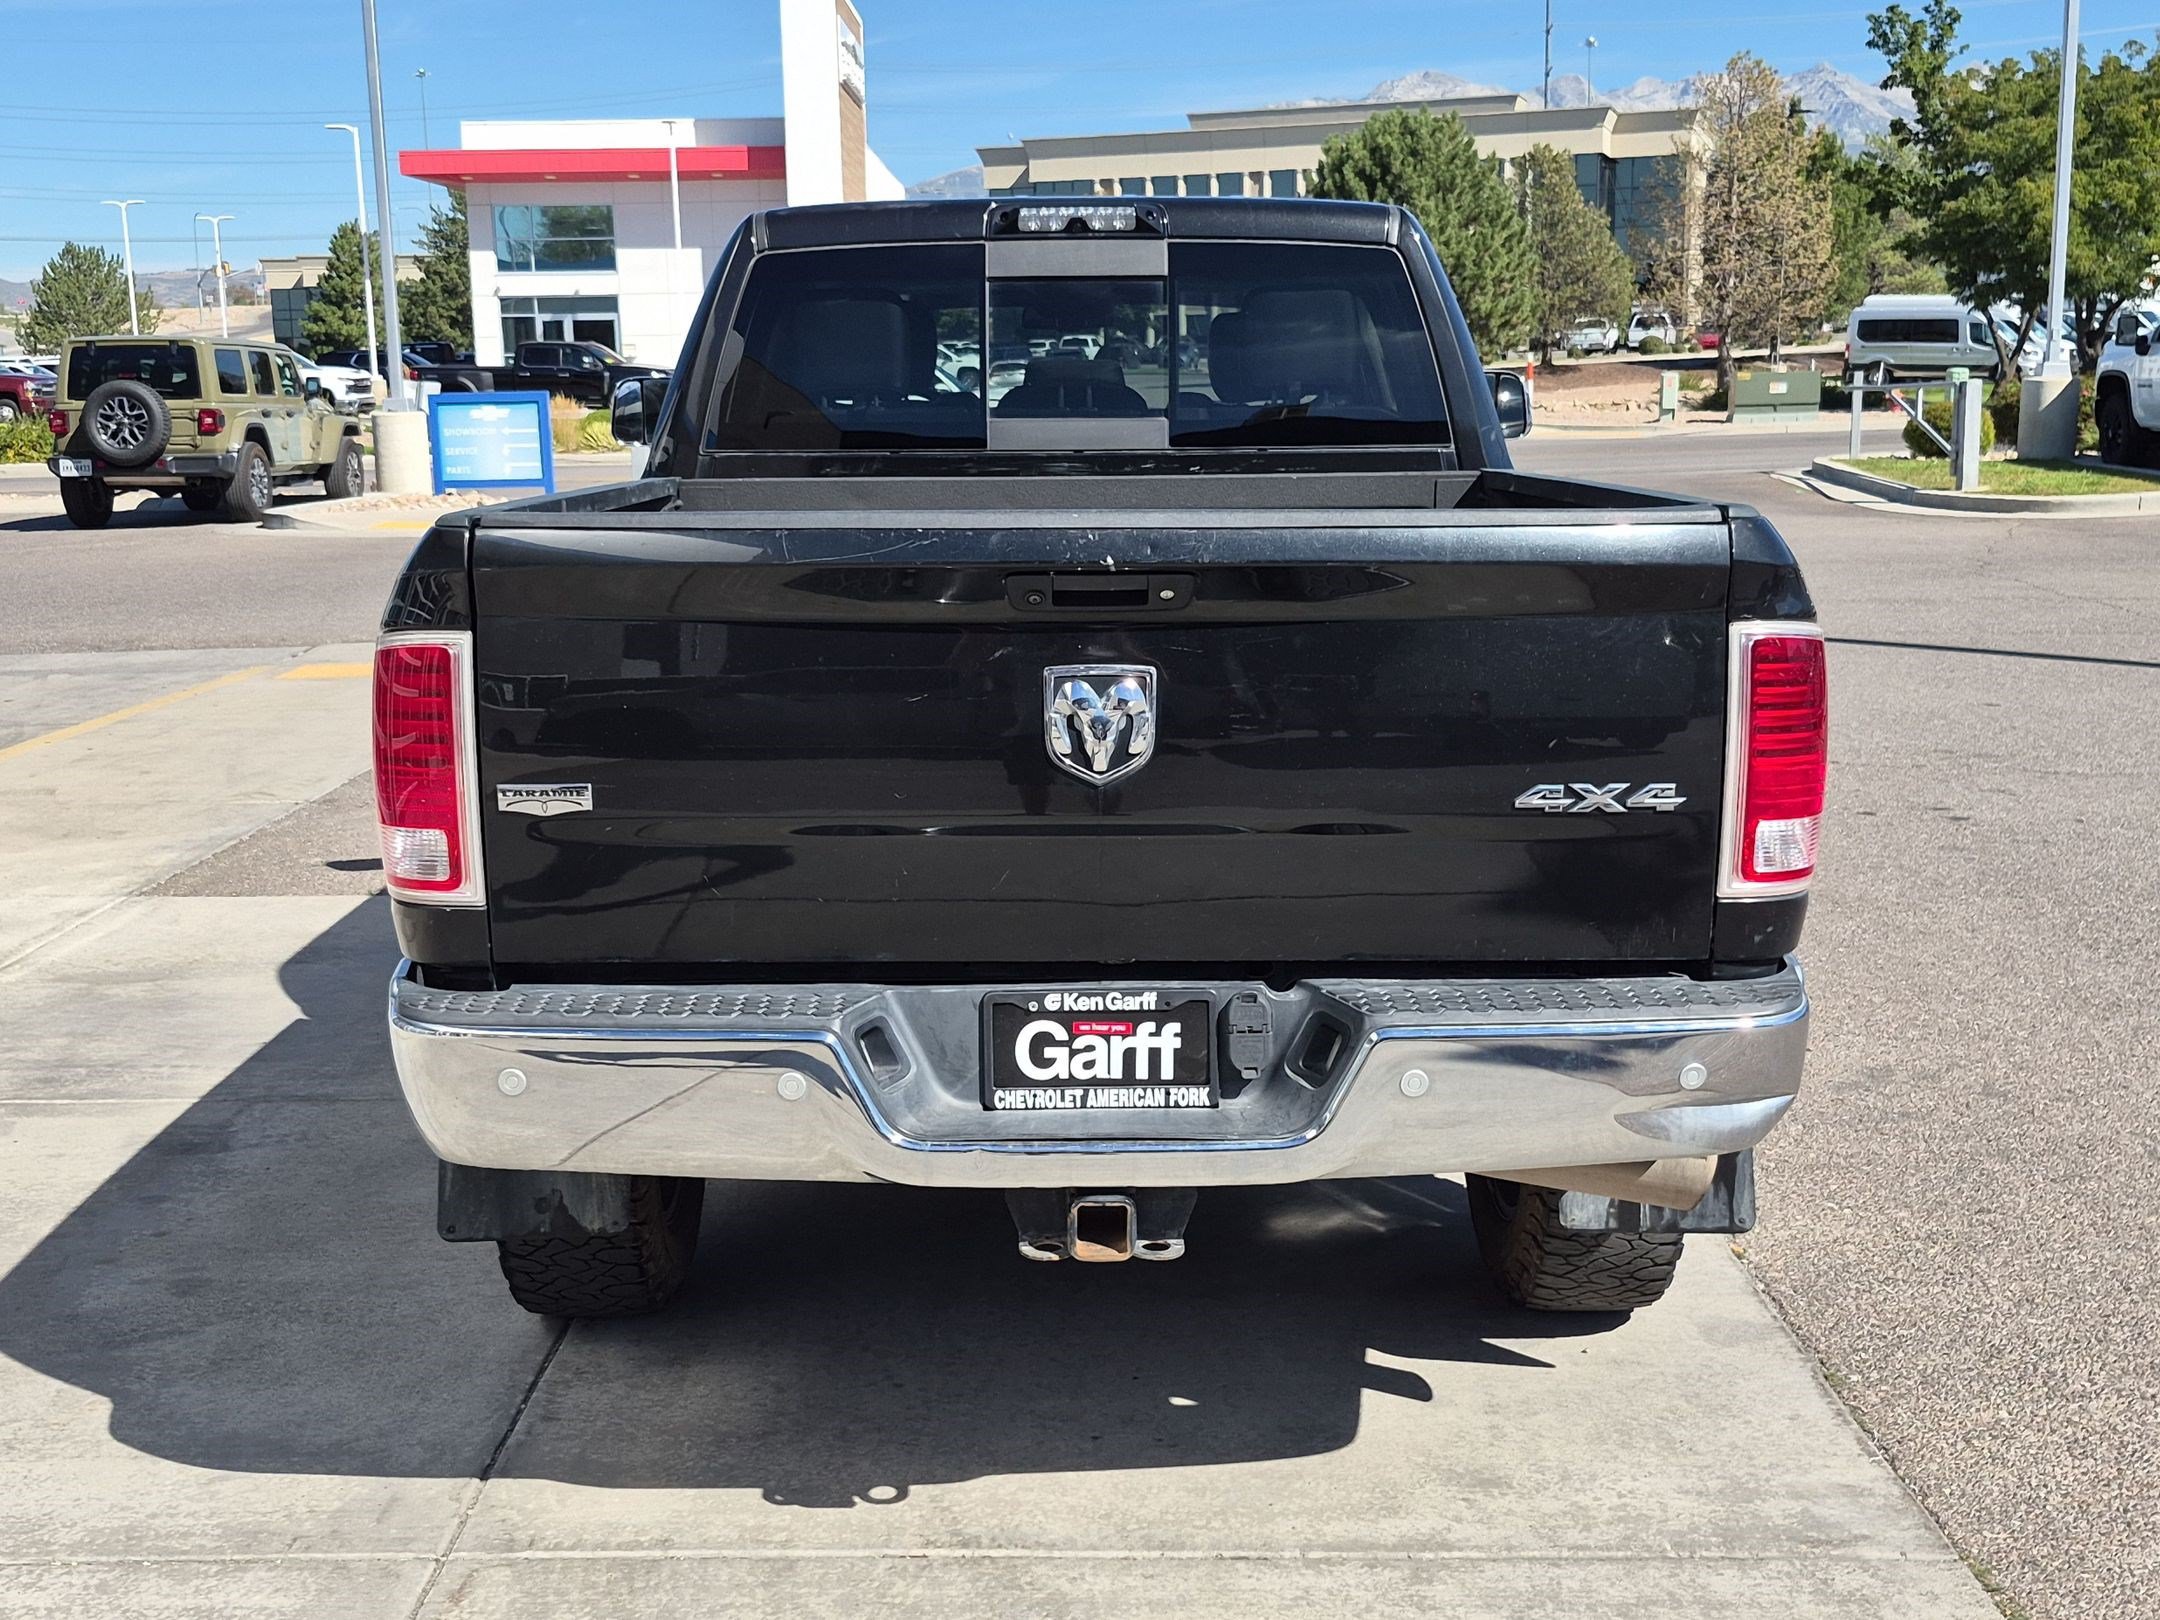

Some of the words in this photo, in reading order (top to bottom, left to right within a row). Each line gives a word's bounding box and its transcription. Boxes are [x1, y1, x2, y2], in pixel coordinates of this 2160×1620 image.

[445, 447, 478, 456] SERVICE
[499, 788, 587, 798] LARAMIE
[1063, 993, 1104, 1012] Ken
[1105, 991, 1157, 1012] Garff
[1091, 1022, 1109, 1031] hear
[1110, 1024, 1126, 1033] you
[1014, 1019, 1182, 1081] Garff
[993, 1089, 1084, 1110] CHEVROLET
[1086, 1088, 1166, 1109] AMERICAN
[1169, 1087, 1211, 1107] FORK
